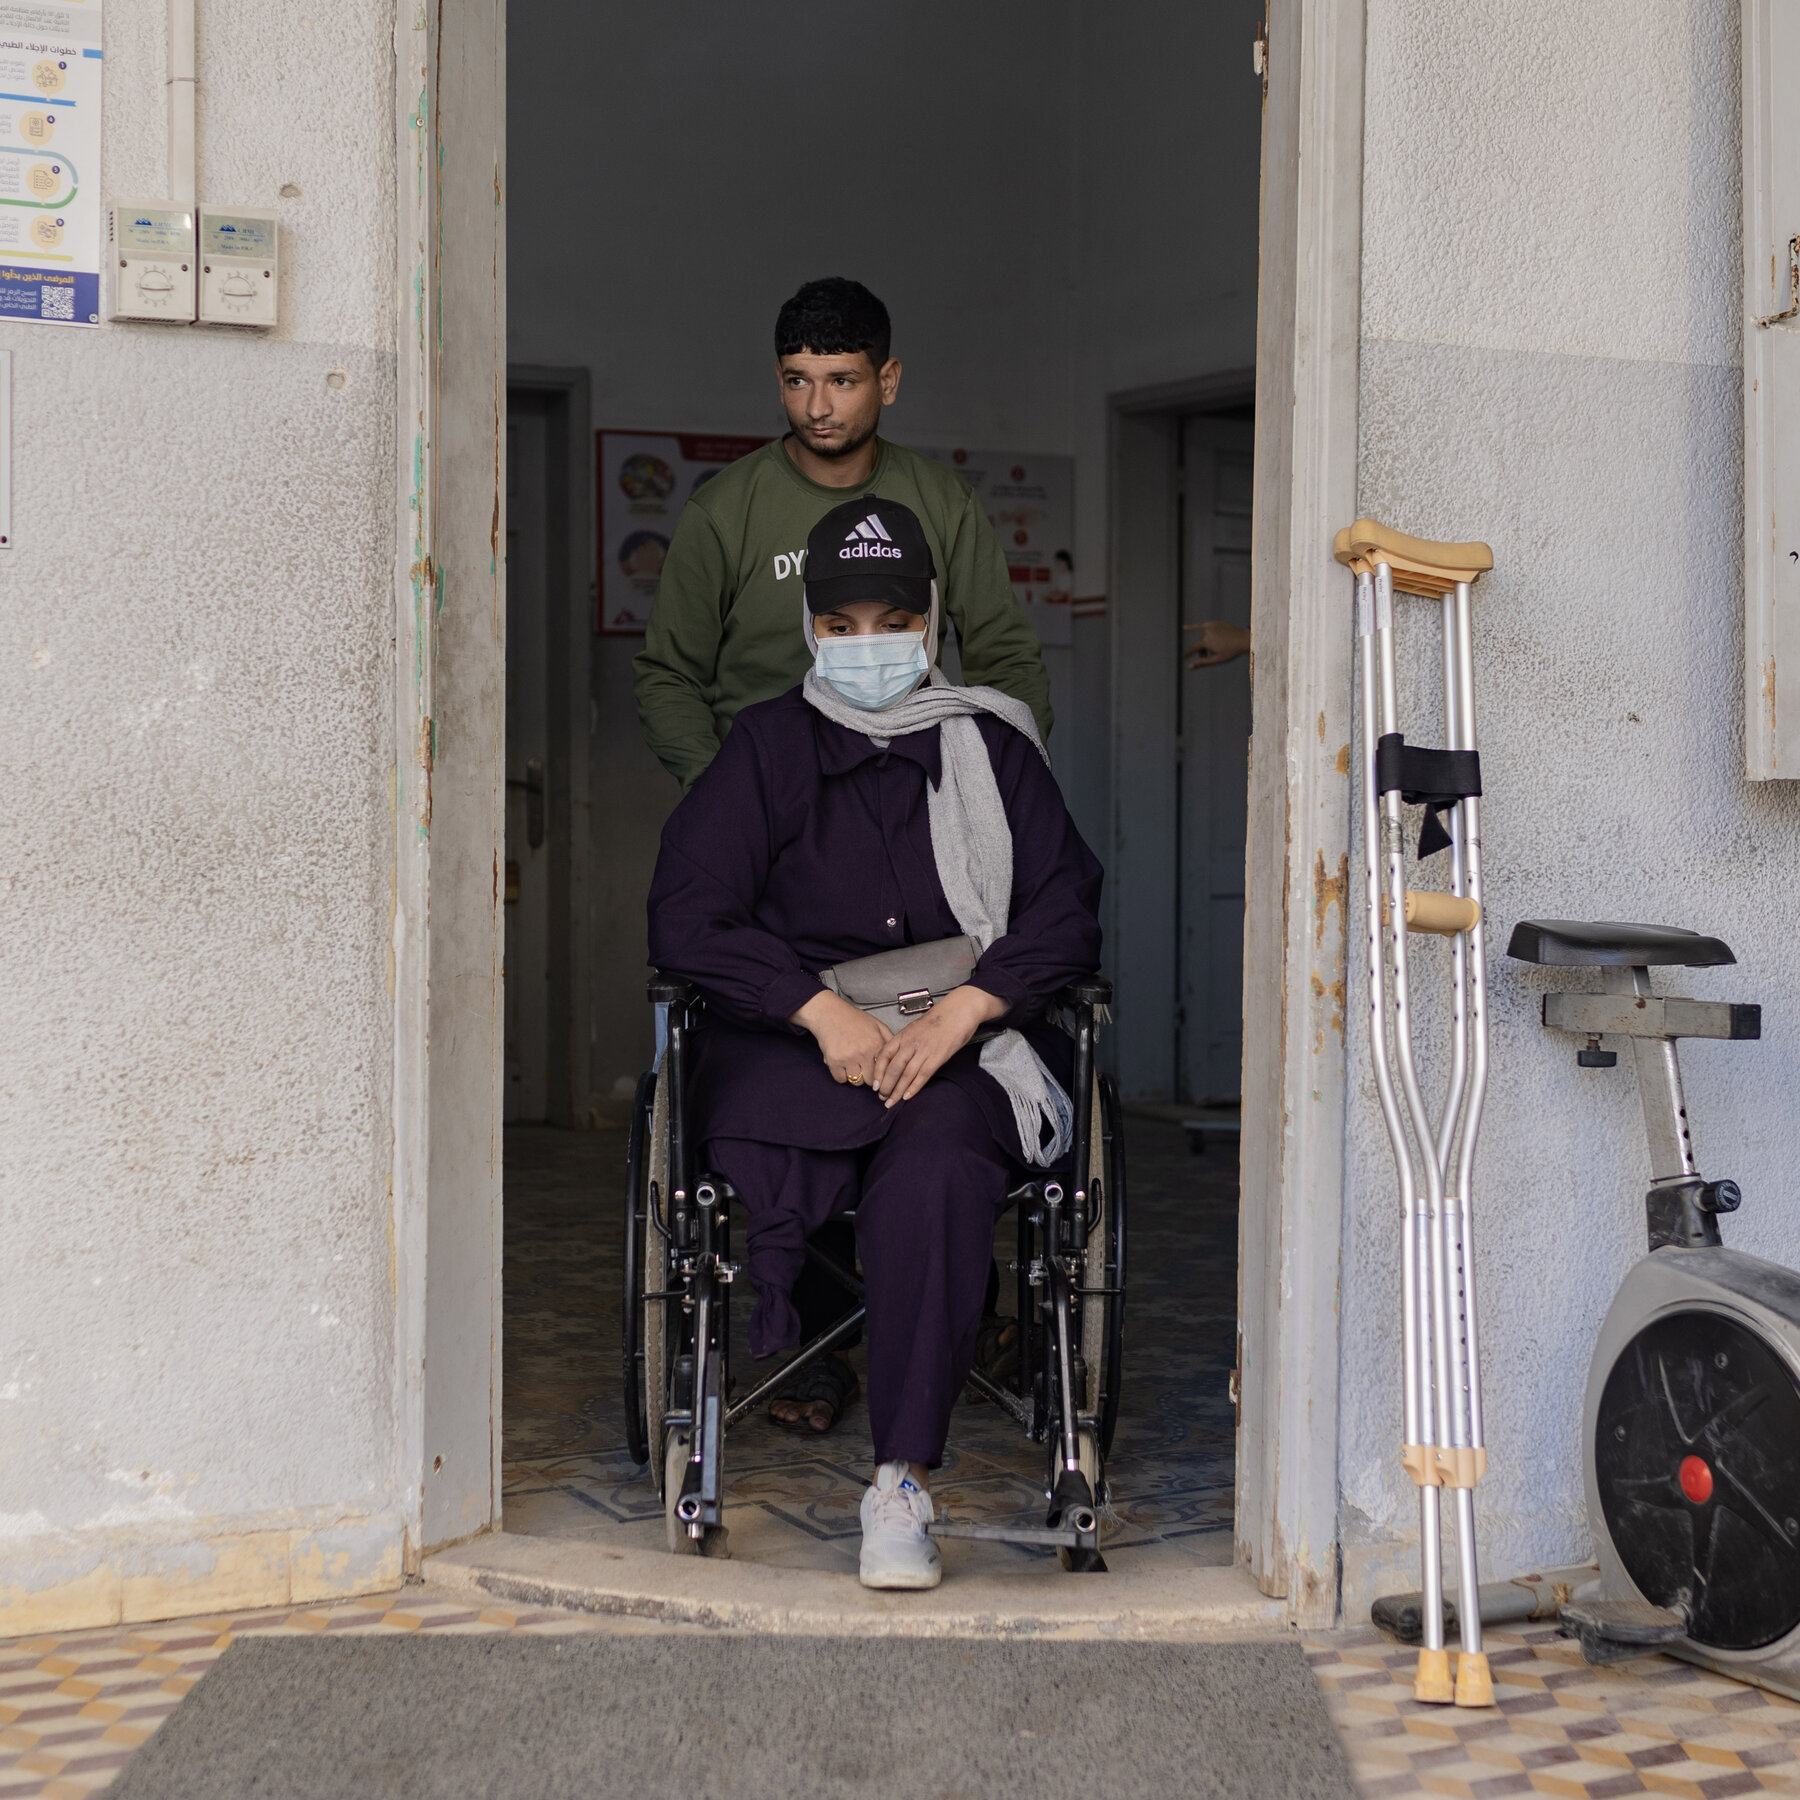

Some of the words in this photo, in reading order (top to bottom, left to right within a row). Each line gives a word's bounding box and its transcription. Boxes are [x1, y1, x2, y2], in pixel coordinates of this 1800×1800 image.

[0, 41, 23, 50] الطبي
[25, 43, 48, 54] الإجلاء
[50, 46, 77, 56] خطوات
[22, 273, 42, 282] الذين
[44, 275, 75, 285] المرضى
[839, 542, 902, 560] adidas
[774, 549, 808, 581] DY
